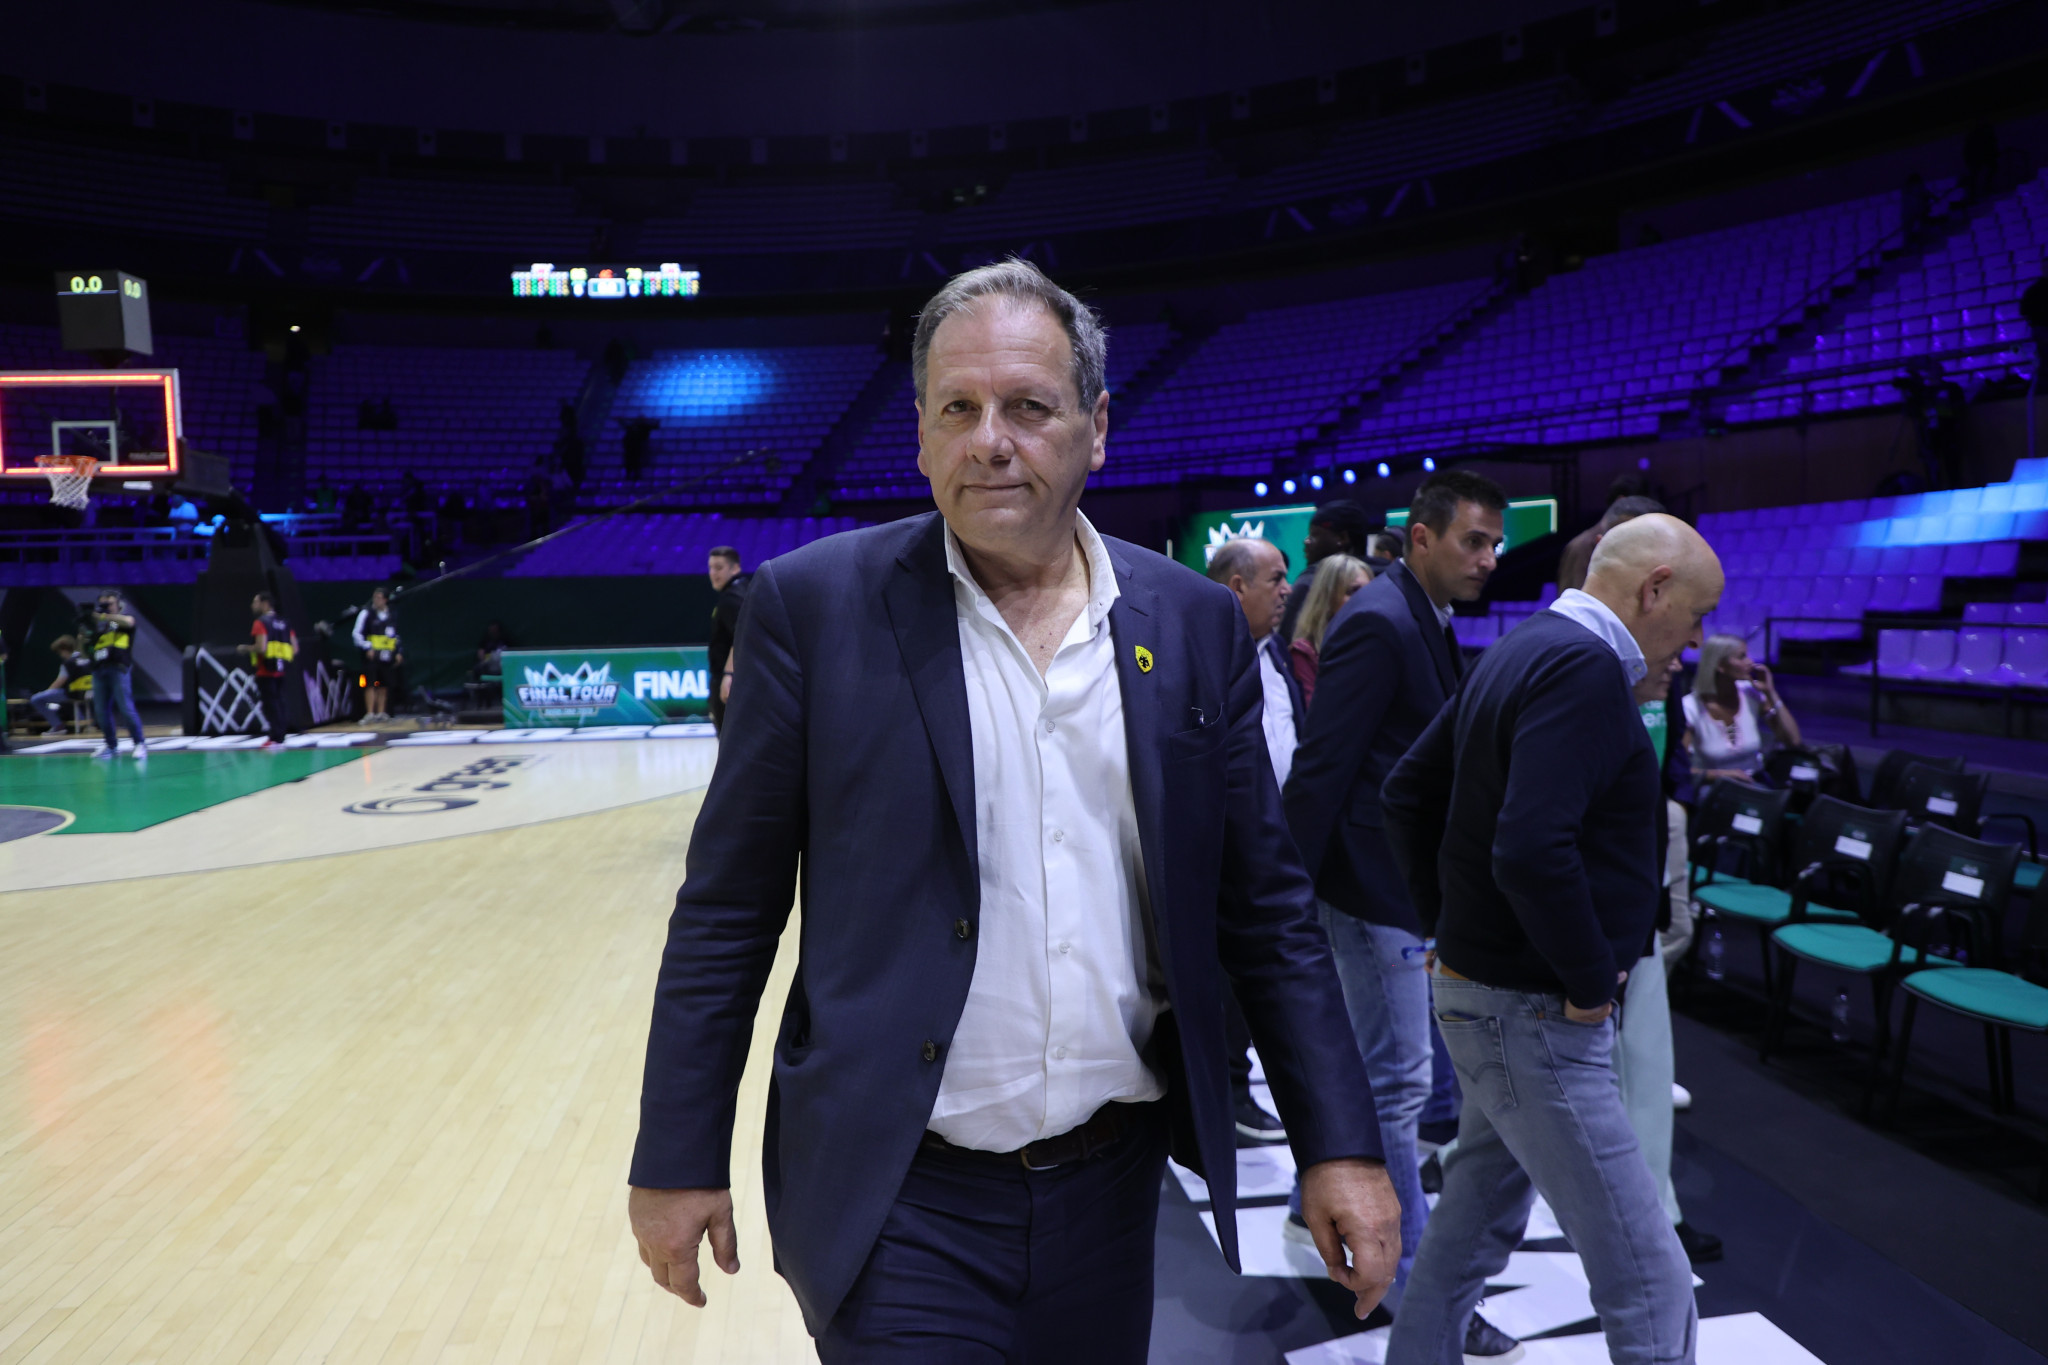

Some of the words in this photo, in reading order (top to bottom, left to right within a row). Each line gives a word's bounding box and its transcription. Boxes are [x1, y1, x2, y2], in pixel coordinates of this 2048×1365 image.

[70, 275, 103, 293] 0.0
[634, 669, 710, 699] FINAL
[518, 686, 569, 702] FINAL
[570, 685, 617, 701] FOUR
